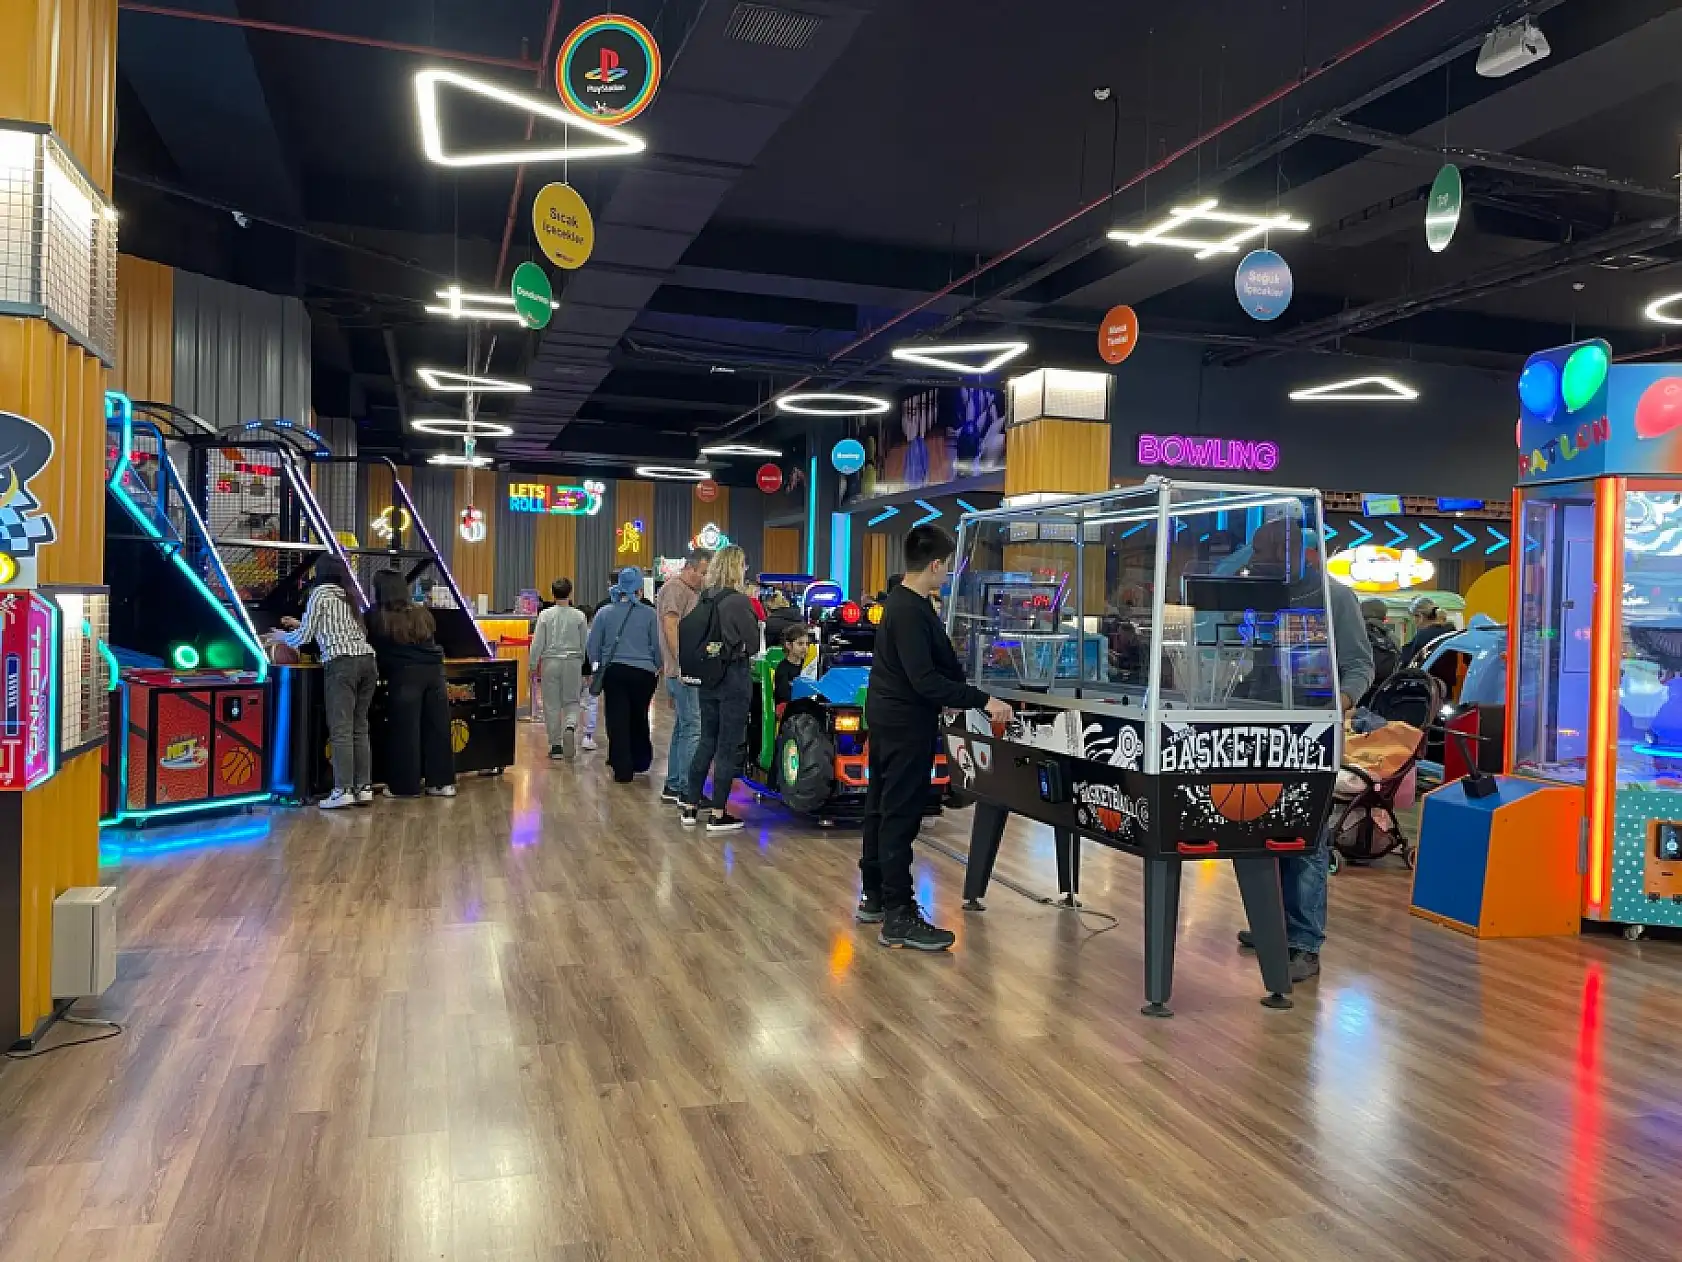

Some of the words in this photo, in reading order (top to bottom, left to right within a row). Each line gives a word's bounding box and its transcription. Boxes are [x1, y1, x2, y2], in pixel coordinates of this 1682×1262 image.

[1138, 434, 1279, 470] BOWLING
[509, 483, 546, 499] LETS
[1161, 725, 1332, 771] BASKETBALL
